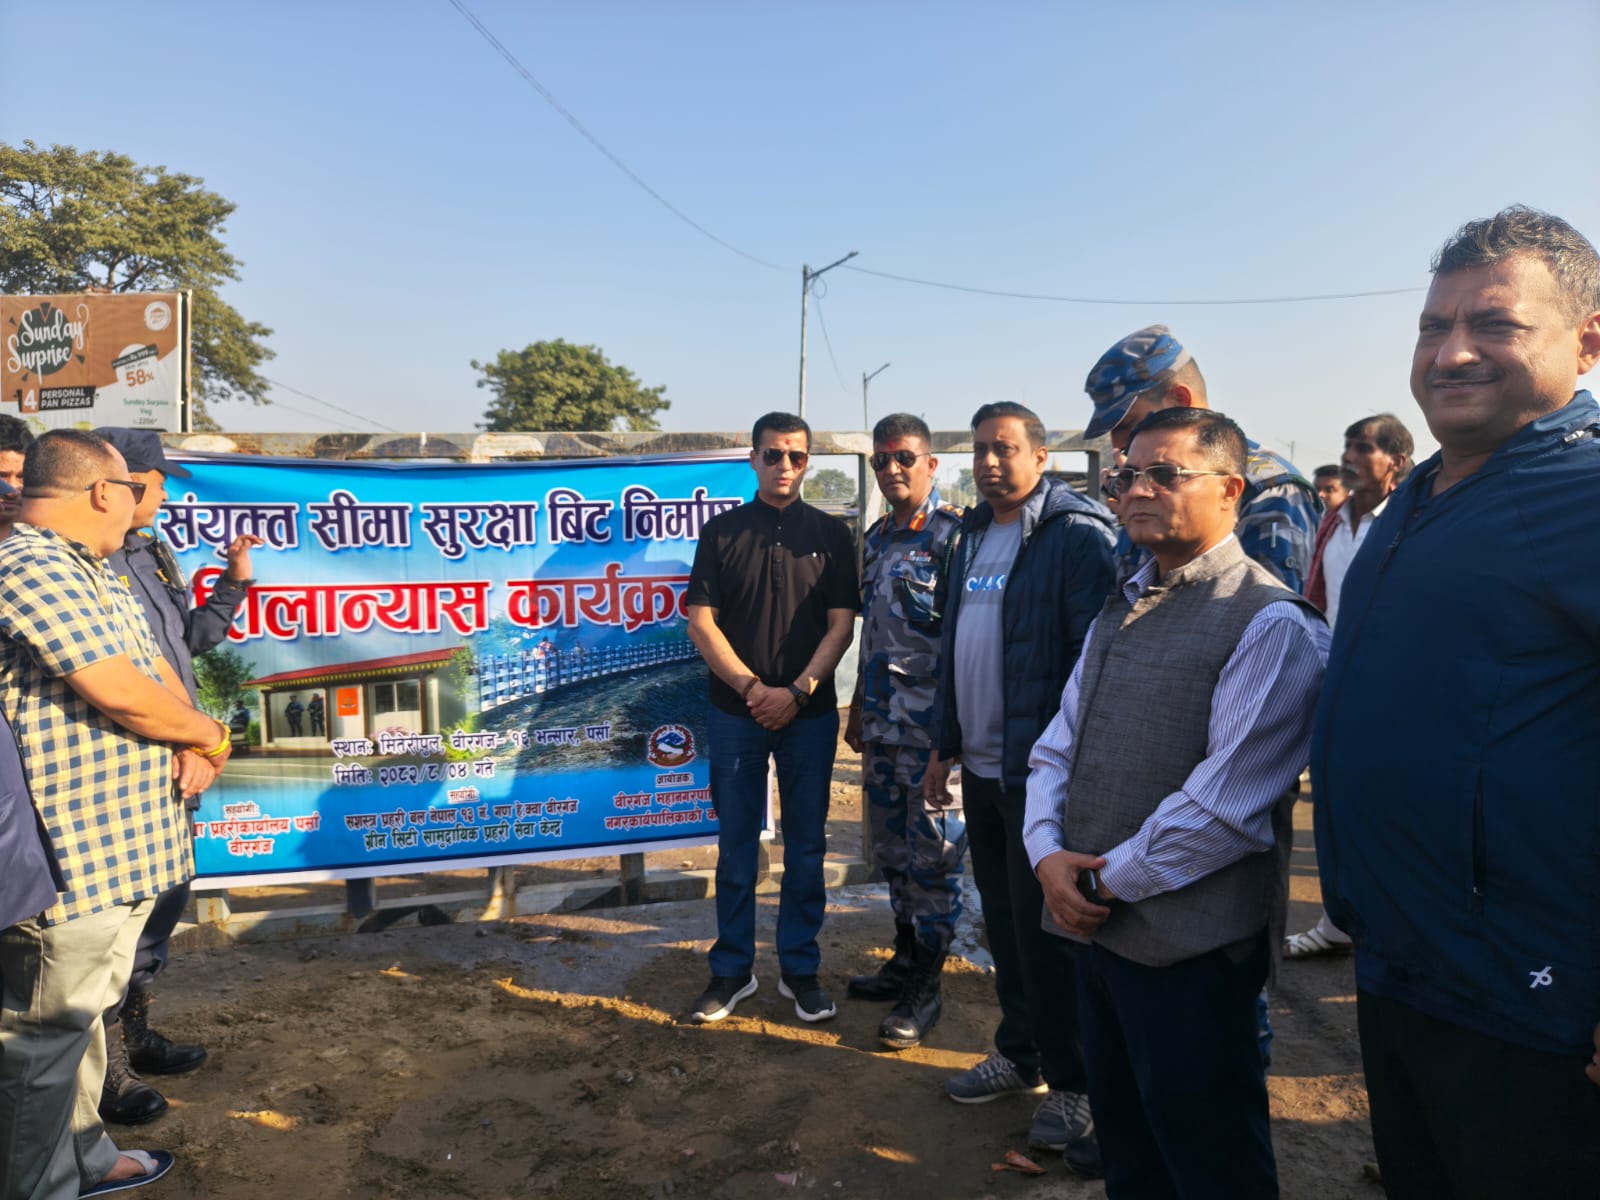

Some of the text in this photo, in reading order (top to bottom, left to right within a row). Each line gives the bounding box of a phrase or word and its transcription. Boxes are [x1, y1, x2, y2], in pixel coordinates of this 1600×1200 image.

[21, 303, 89, 349] Sunday
[7, 335, 73, 384] Surprise
[125, 368, 155, 388] 58%
[24, 389, 37, 410] 4
[41, 388, 86, 399] PERSONAL
[41, 396, 91, 408] PAN PIZZAS
[159, 494, 297, 559] संयुक्त
[310, 491, 410, 548] सीमा
[422, 502, 536, 557] सुरक्षा
[547, 489, 612, 541] बिट
[586, 721, 611, 741] पर्सा
[475, 757, 495, 777] गते
[614, 792, 651, 810] वीरगंज
[295, 813, 321, 831] पर्सा
[345, 815, 377, 830] सशस्त्र
[381, 809, 405, 827] प्रहरी
[409, 812, 426, 825] बल
[430, 808, 456, 823] नेपाल
[546, 798, 578, 816] वीरगंज
[365, 816, 561, 850] ग्रीन सिटी सामुदायिक प्रहरी सेवा केन्द्र
[230, 838, 273, 857] वीरगंज
